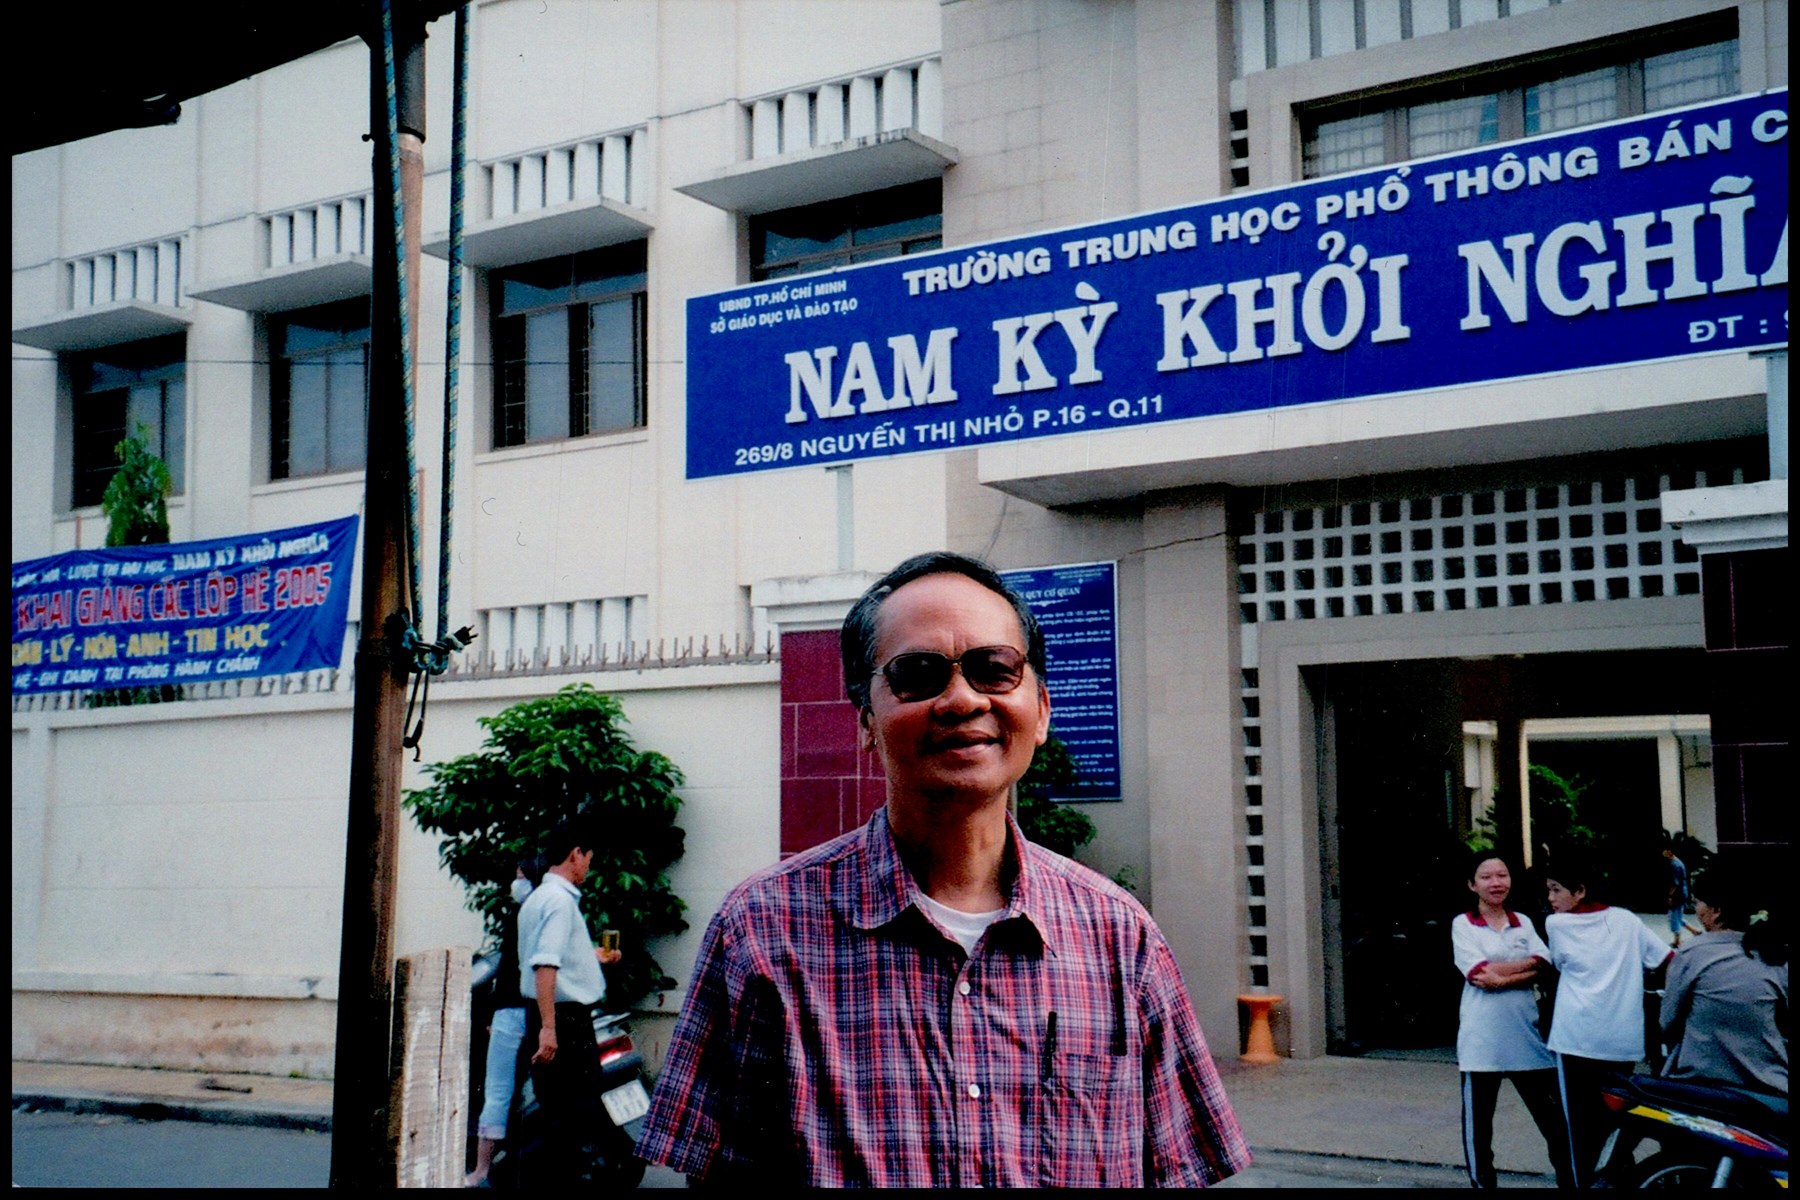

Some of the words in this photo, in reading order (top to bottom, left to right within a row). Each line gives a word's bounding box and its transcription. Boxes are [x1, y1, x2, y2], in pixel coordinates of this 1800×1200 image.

[903, 247, 1051, 295] TRƯỜNG
[1061, 219, 1196, 268] TRUNG
[1211, 202, 1301, 244] HỌC
[1316, 167, 1412, 224] PHỔ
[1425, 151, 1599, 203] THÔNG
[1618, 119, 1732, 169] BÁN
[719, 297, 751, 313] UBND
[790, 282, 812, 300] CHÍ
[815, 280, 847, 296] MINH
[728, 313, 756, 331] GIÁO
[758, 311, 783, 327] DỤC
[785, 304, 802, 321] VÀ
[804, 300, 830, 318] ĐÀO
[832, 297, 858, 315] TẠO
[784, 328, 958, 424] NAM
[993, 280, 1118, 396] KỲ
[1156, 230, 1411, 372] KHỞI
[1688, 314, 1743, 343] ĐT
[735, 442, 794, 467] 269/8
[801, 421, 907, 456] NGUYỄN
[914, 422, 958, 447] THỊ
[964, 405, 1024, 437] NHỎ
[1033, 404, 1087, 429] P.16
[1108, 393, 1164, 420] Q.11
[173, 551, 211, 571] NAM
[17, 589, 72, 632] KHAI
[77, 577, 145, 626] GIẢNG
[150, 575, 190, 620] CÁC
[274, 561, 332, 611] 2005
[184, 627, 218, 654] TIN
[224, 622, 270, 652] HỌC
